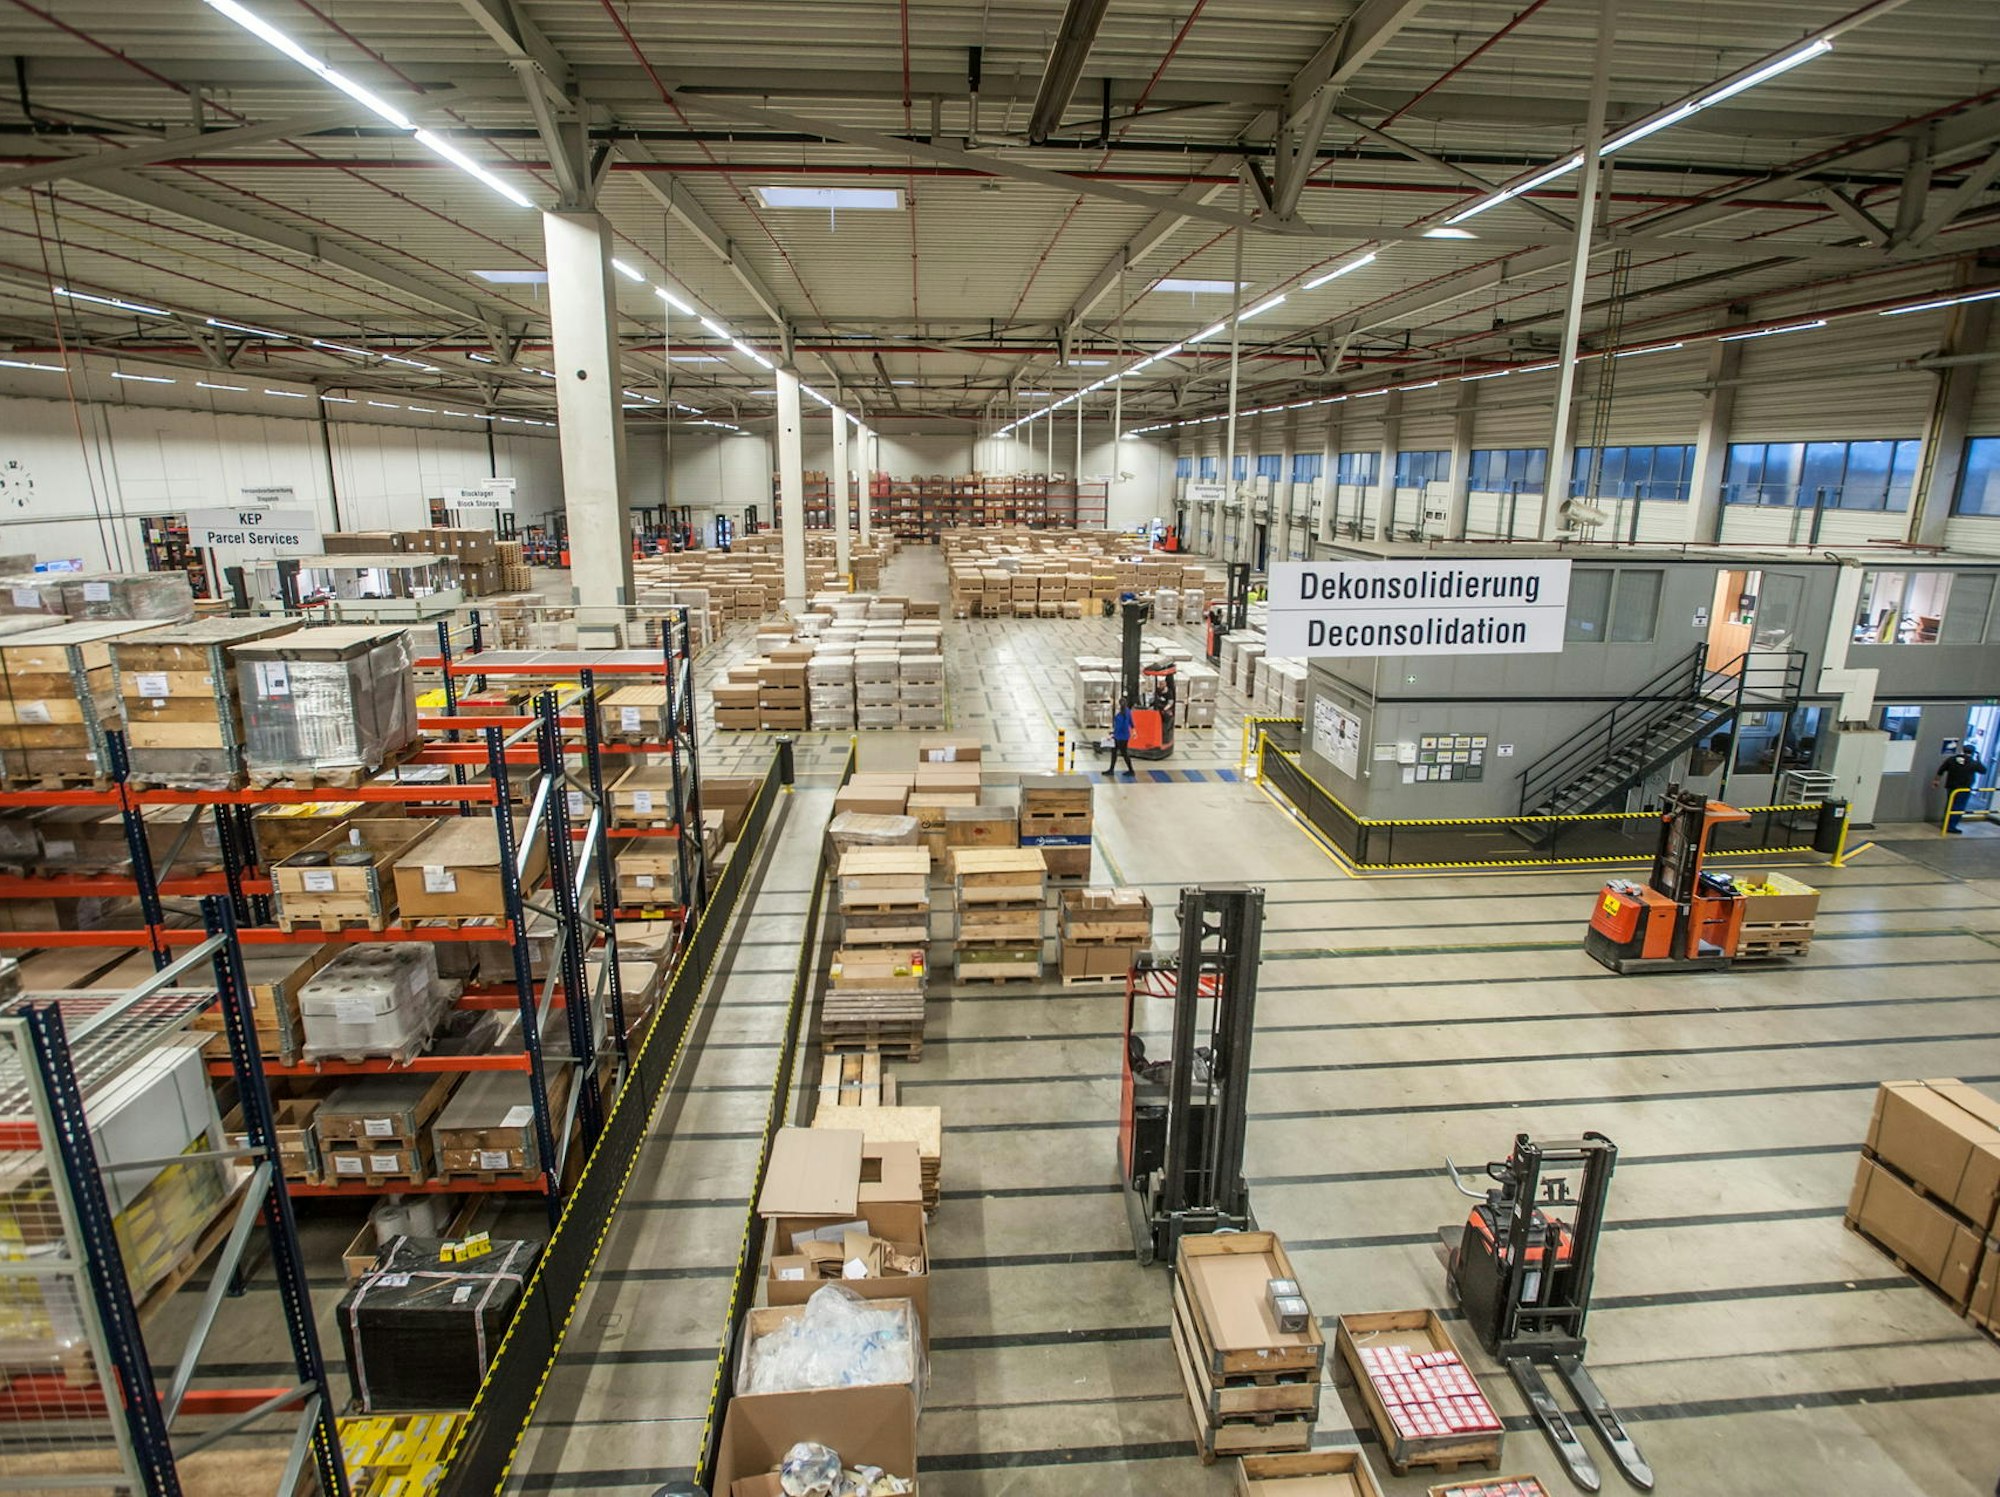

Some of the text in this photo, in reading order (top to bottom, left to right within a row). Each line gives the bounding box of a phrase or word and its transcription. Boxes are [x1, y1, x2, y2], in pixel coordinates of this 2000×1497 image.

[239, 513, 262, 525] KEP
[208, 531, 299, 545] Parcel Services
[1300, 571, 1540, 603] Dekonsolidierung
[1308, 617, 1526, 647] Deconsolidation
